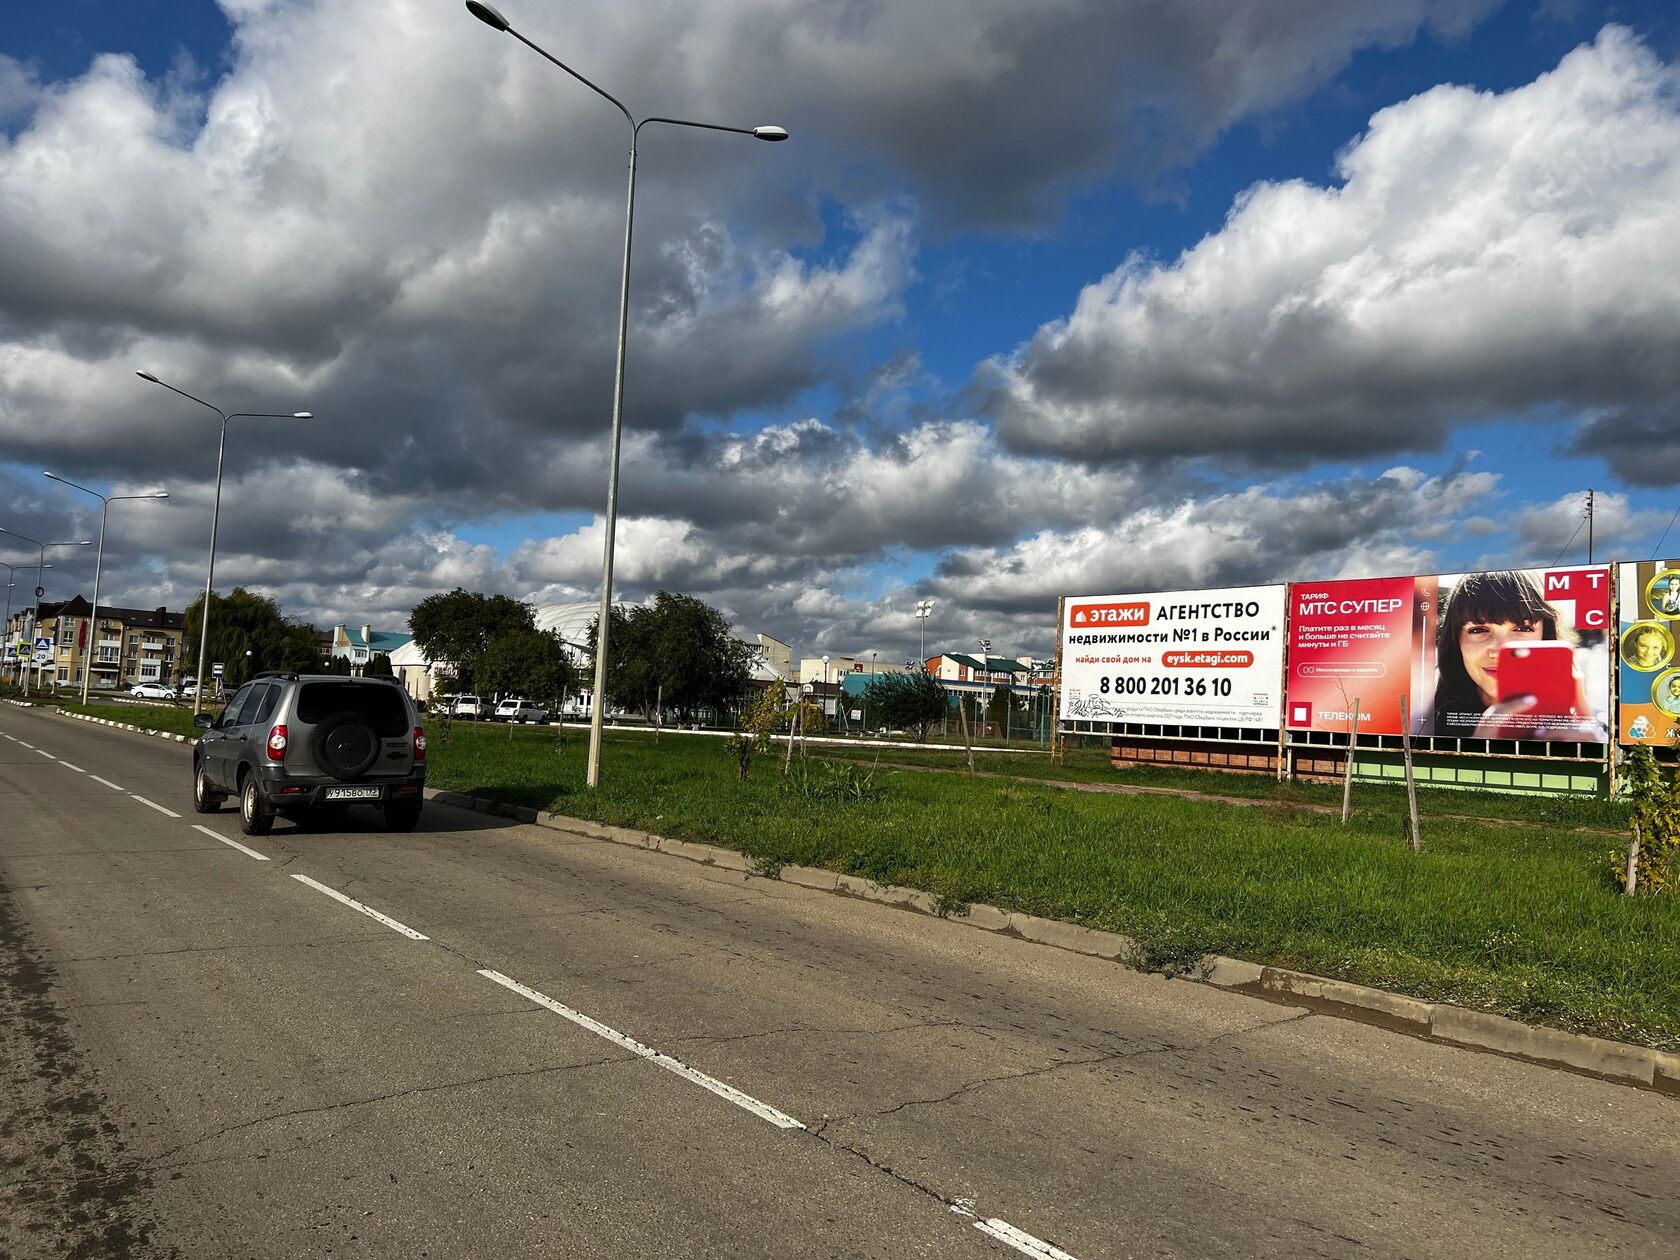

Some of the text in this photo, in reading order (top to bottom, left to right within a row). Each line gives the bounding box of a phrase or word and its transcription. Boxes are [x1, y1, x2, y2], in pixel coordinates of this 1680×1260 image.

[1548, 573, 1605, 591] М Т
[1156, 601, 1260, 621] АГЕНТСТВО
[1300, 598, 1402, 616] МТС СУПЕР
[1585, 610, 1604, 626] С
[1068, 632, 1168, 646] недвижимости
[1172, 628, 1197, 642] №1
[1202, 632, 1209, 642] в
[1076, 656, 1100, 664] найди
[1101, 654, 1120, 664] свой
[1166, 652, 1248, 666] eysk.etagi.com
[1100, 676, 1110, 694] 8
[1115, 677, 1146, 694] 800
[1150, 677, 1178, 696] 201
[1184, 678, 1206, 696] 36
[1212, 678, 1232, 697] 10
